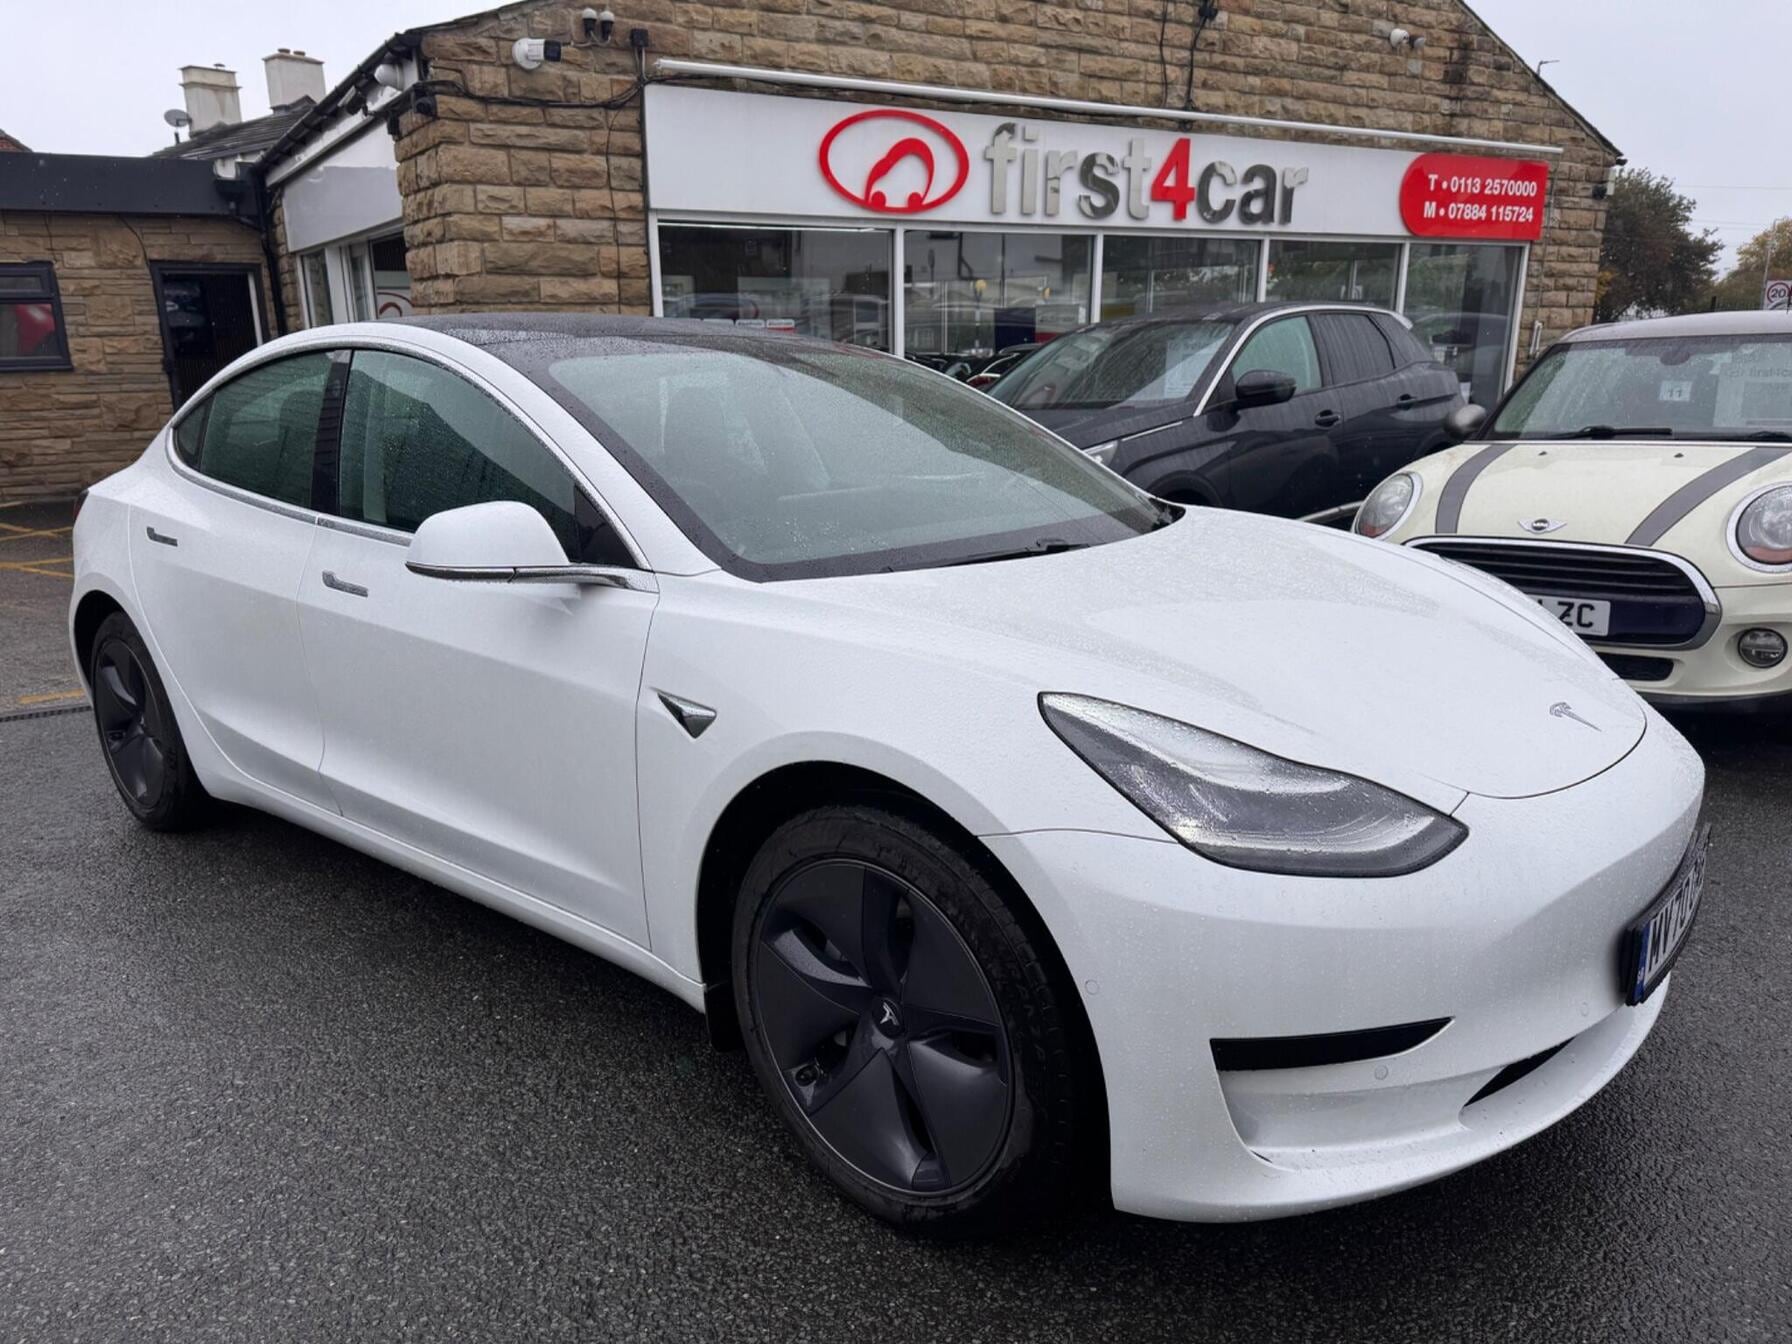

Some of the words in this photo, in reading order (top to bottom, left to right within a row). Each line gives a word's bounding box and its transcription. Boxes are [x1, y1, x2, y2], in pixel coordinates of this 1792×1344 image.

[984, 121, 1309, 225] first4car
[1428, 174, 1438, 191] T
[1450, 176, 1481, 194] 0113
[1484, 178, 1537, 197] 2570000
[1423, 201, 1436, 219] M
[1448, 202, 1487, 220] 07884
[1491, 205, 1534, 222] 115724
[1770, 287, 1787, 299] 20
[1537, 599, 1595, 628] ZC
